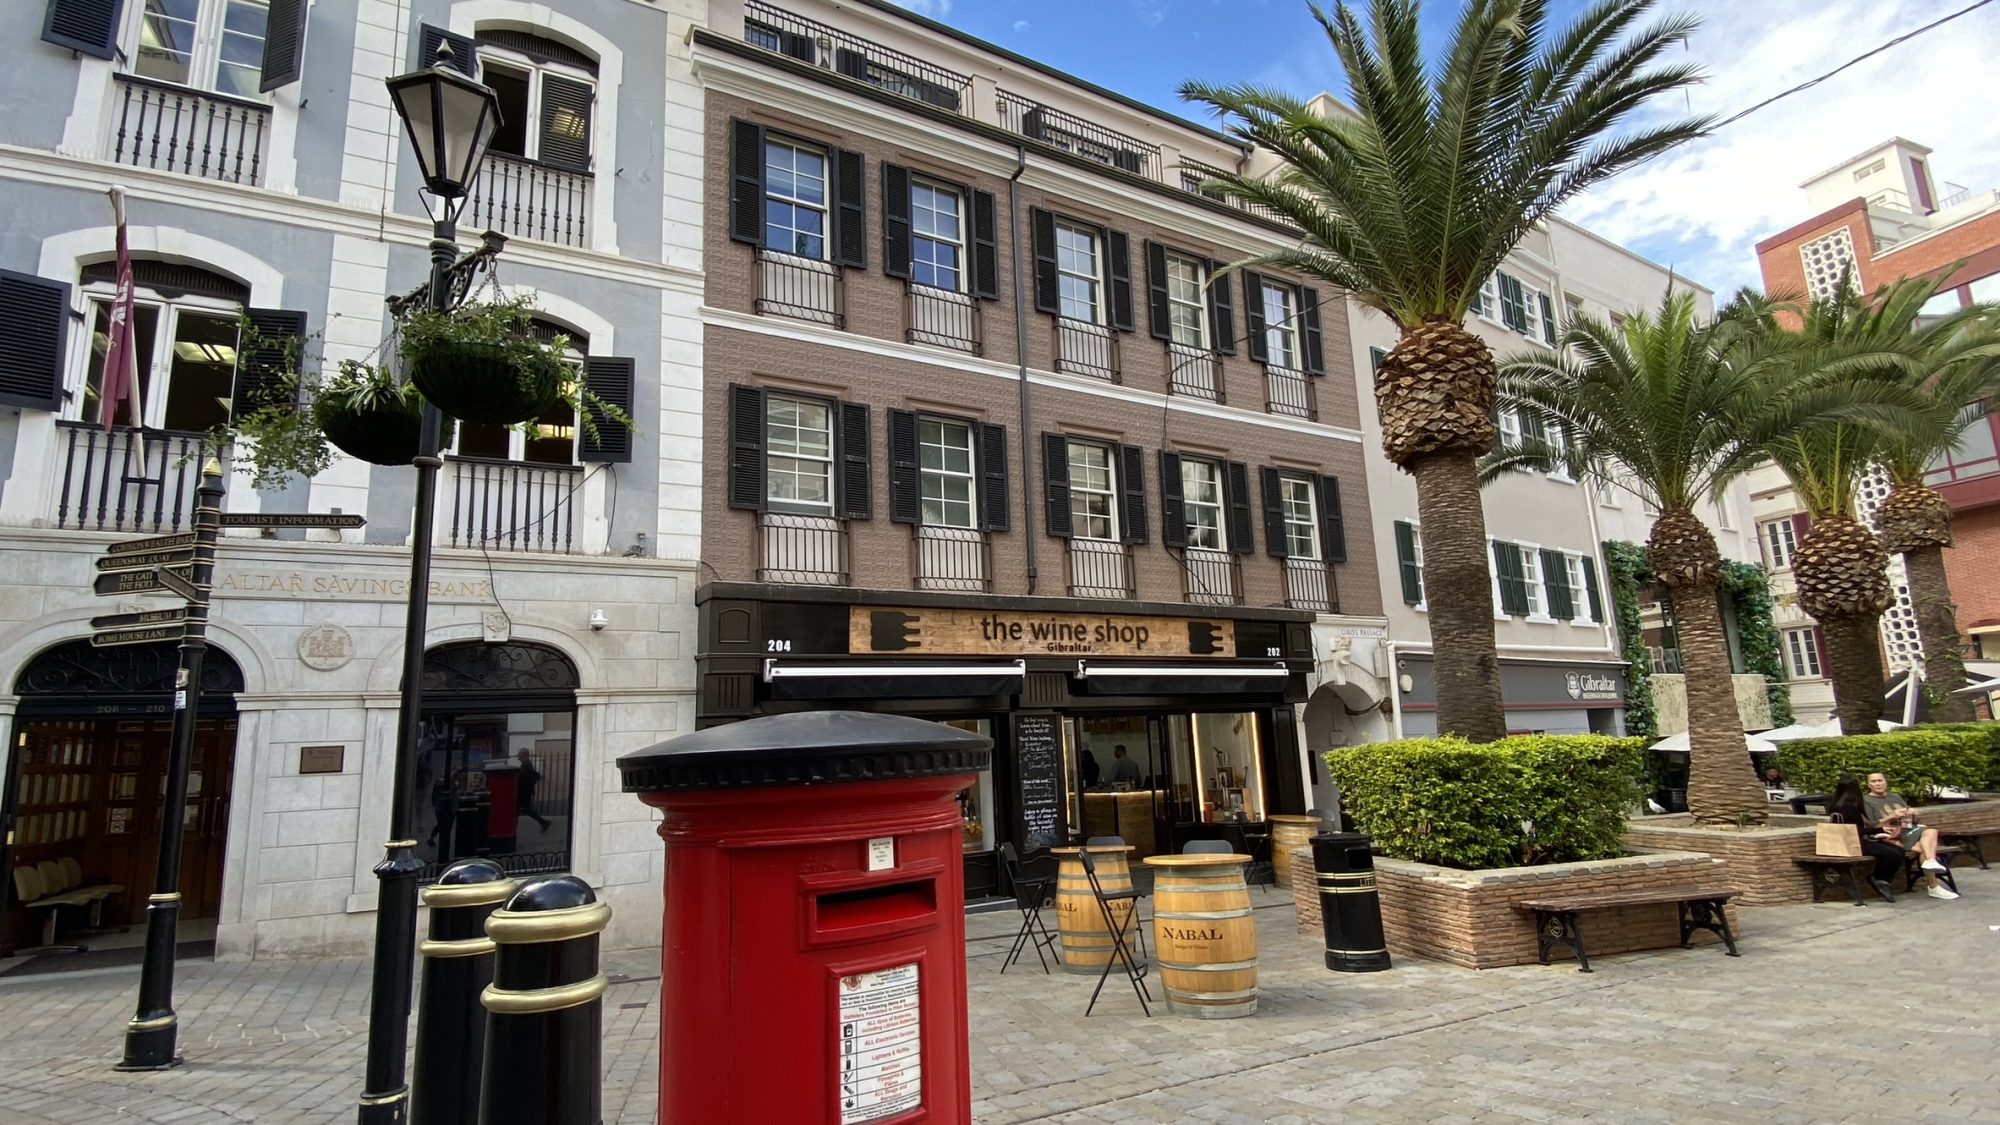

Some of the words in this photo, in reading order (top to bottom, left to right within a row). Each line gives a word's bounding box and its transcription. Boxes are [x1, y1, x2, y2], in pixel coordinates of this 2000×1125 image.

[224, 515, 275, 524] TOURIST
[279, 516, 360, 525] INFORMATION
[101, 556, 146, 567] QUEENSWAY
[149, 553, 171, 563] QUAY
[120, 574, 135, 583] THE
[119, 582, 134, 591] THE
[428, 581, 493, 597] BANK
[119, 631, 145, 642] HOUSE
[146, 629, 167, 639] LANE
[981, 614, 1023, 641] the
[1031, 617, 1087, 642] wine
[1094, 618, 1149, 650] shop
[768, 639, 791, 652] 204
[1047, 642, 1092, 653] Gibraltar
[1267, 647, 1280, 657] 202
[1580, 674, 1616, 691] Gibraltar
[145, 704, 166, 713] 210
[1162, 926, 1223, 940] NABAL
